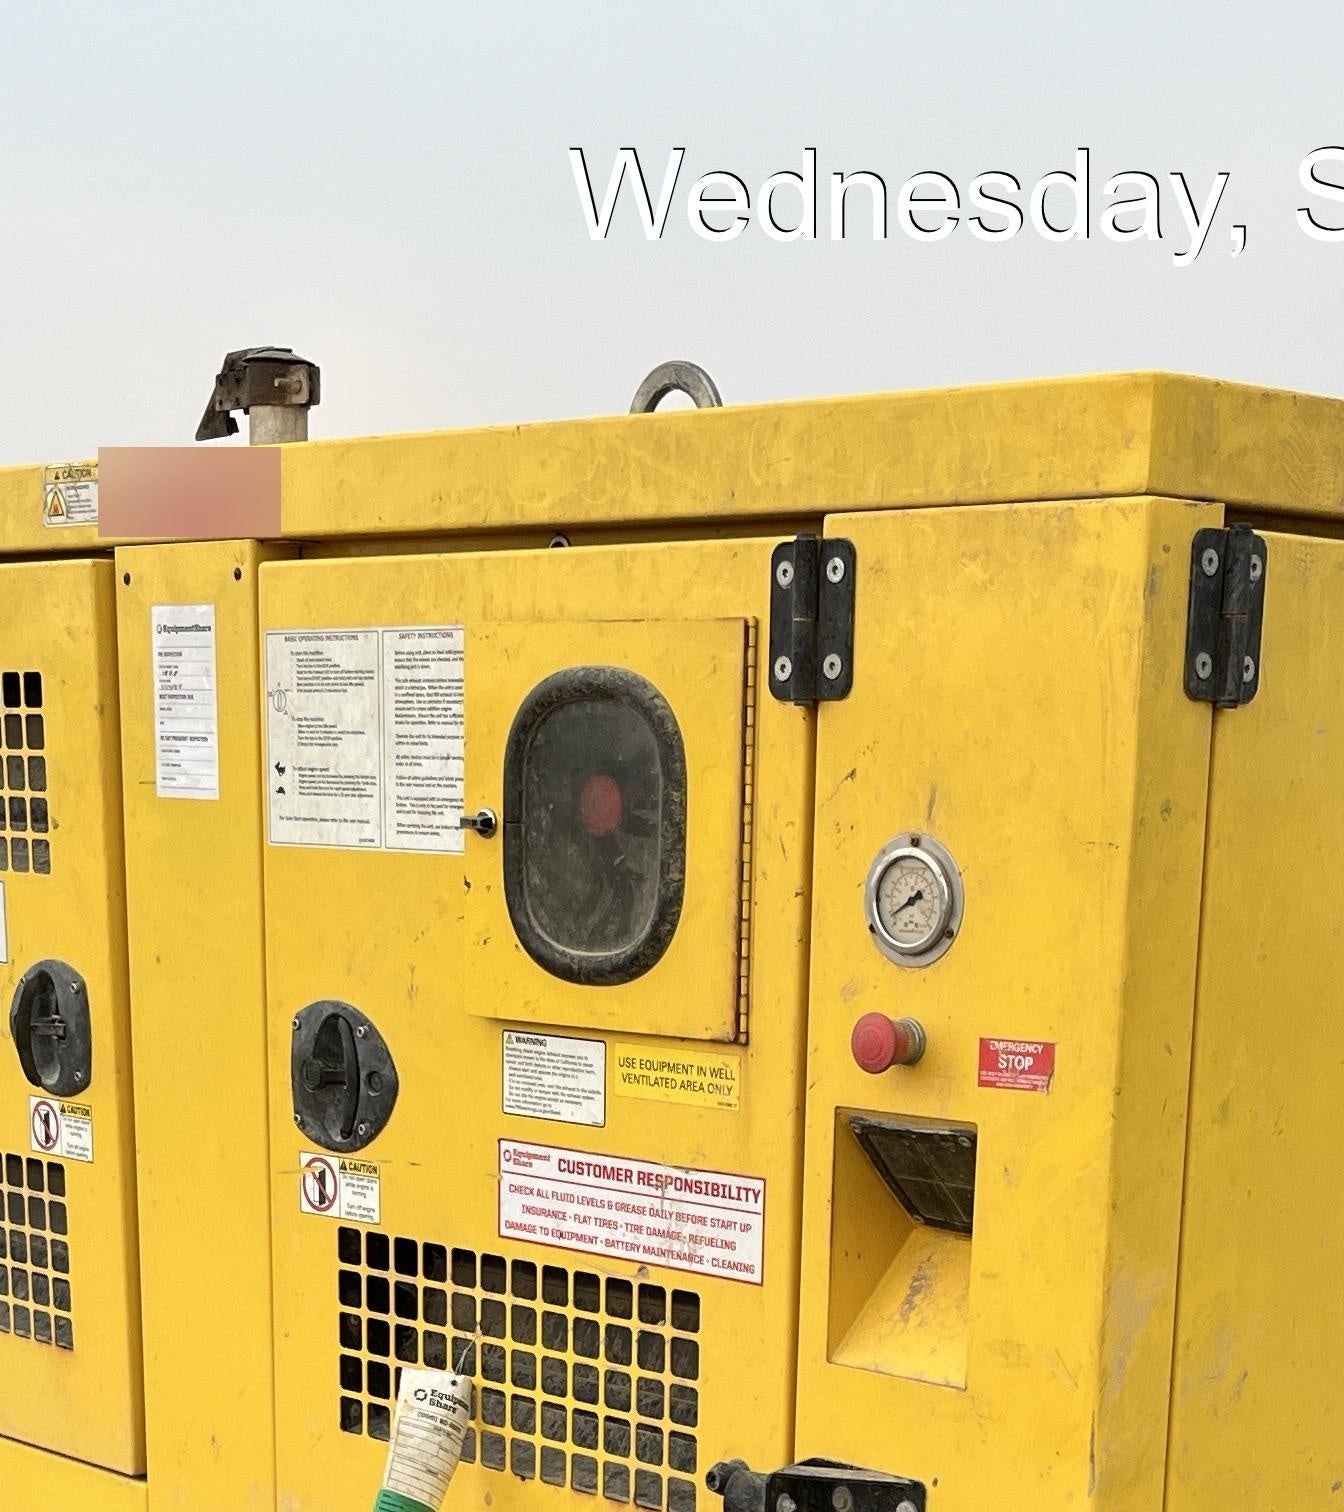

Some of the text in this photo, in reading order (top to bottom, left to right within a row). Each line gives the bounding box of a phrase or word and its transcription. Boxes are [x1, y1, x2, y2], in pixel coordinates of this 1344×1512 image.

[515, 1036, 548, 1048] WARNING
[990, 1040, 1043, 1055] EMERGENCY
[618, 1056, 736, 1081] USE EQUIPMENT IN WELL
[998, 1054, 1034, 1071] STOP
[621, 1073, 733, 1096] VENTILATED AREA ONLY
[348, 1161, 377, 1174] CAUTION
[557, 1158, 762, 1205] CUSTOMER RESPONSIBILITY
[508, 1183, 535, 1197] CHECK
[536, 1188, 550, 1201] ALL
[551, 1191, 575, 1204] FLUID
[577, 1195, 606, 1210] LEVELS
[614, 1201, 648, 1217] GREASE
[648, 1207, 674, 1221] DAILY
[675, 1211, 708, 1227] BEFORE
[709, 1217, 738, 1231] START
[739, 1222, 753, 1234] UP
[521, 1204, 737, 1251] INSURANCE FLAT TIRES TIRE DAMAGE REFUELING
[505, 1220, 756, 1275] DAMAGE TO EQUIPMENT BATTERY MAINTENANCE CLEANING
[430, 1389, 469, 1412] Equip
